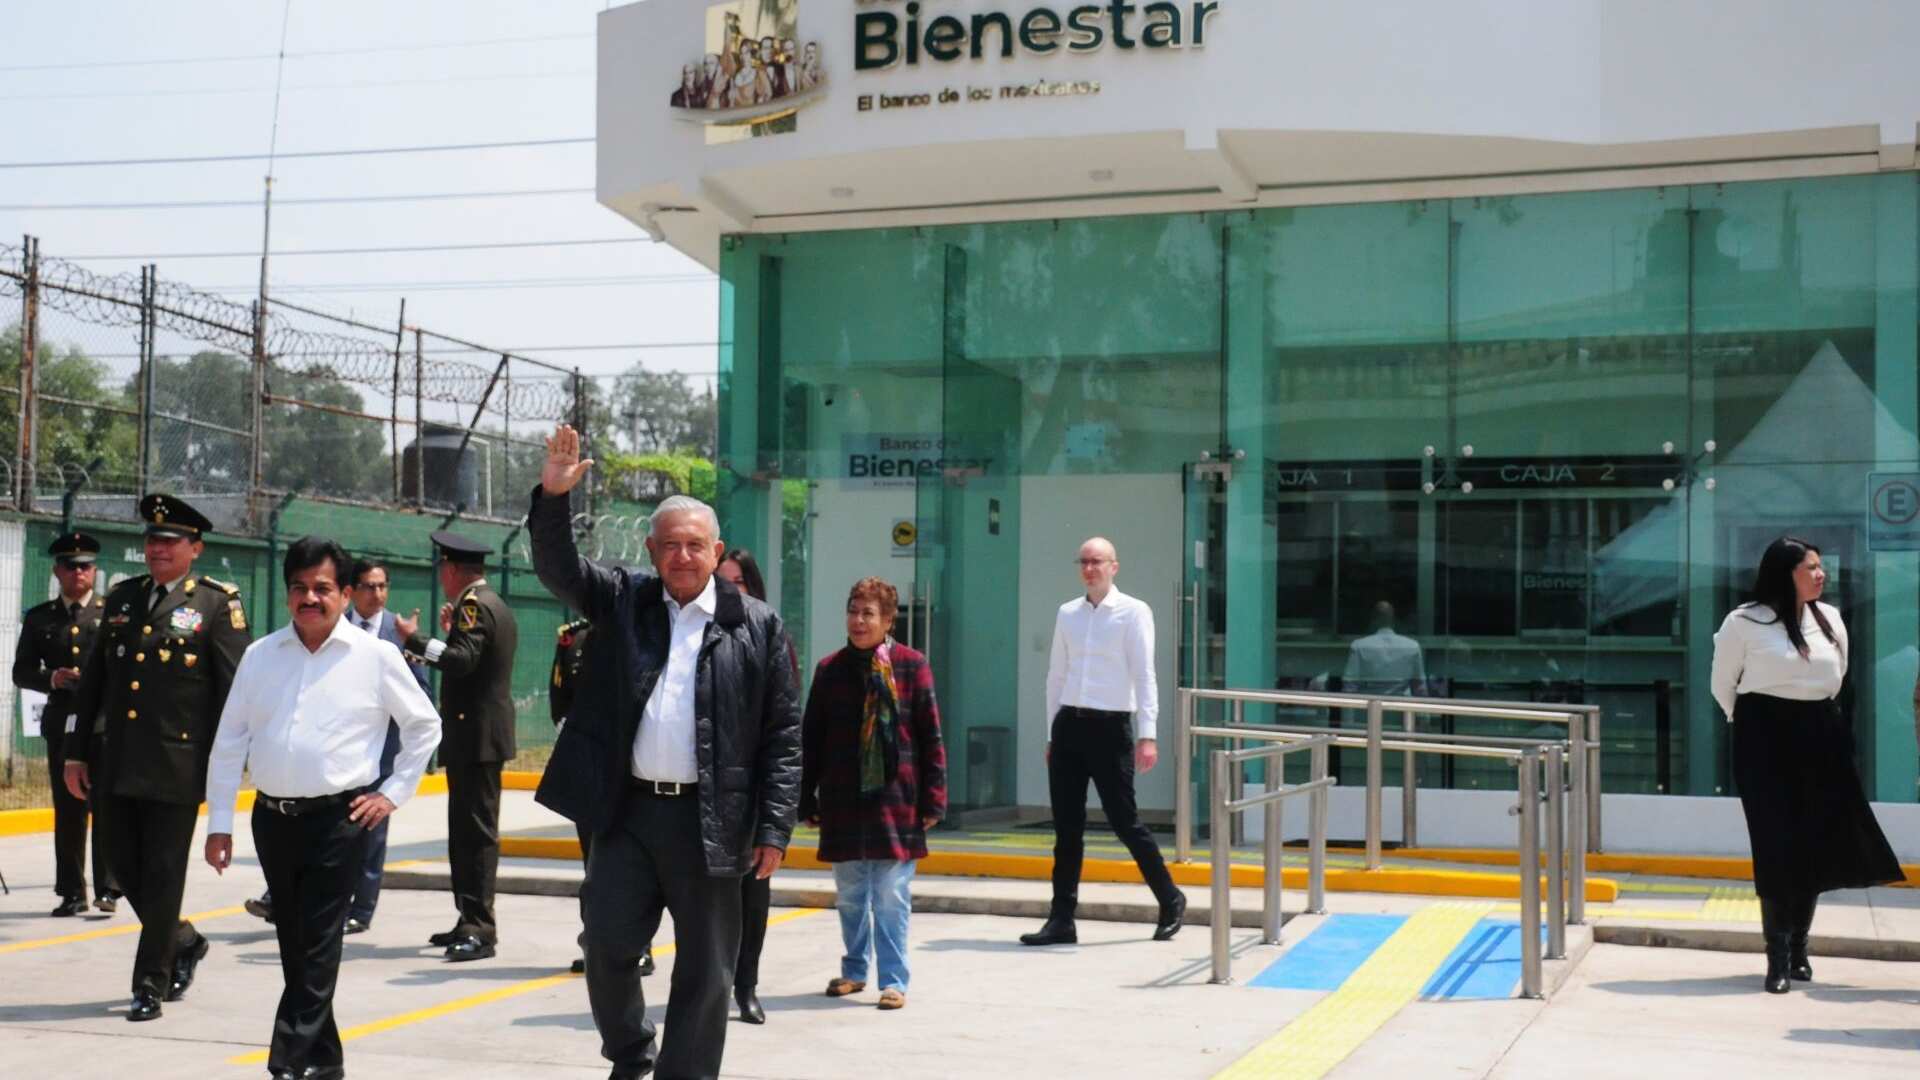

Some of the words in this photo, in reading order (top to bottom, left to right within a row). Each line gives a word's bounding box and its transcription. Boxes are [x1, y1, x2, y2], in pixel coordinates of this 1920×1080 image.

[855, 1, 1218, 69] Bienestar
[857, 96, 873, 111] El
[880, 93, 931, 109] banco
[938, 88, 960, 104] de
[1343, 467, 1351, 485] 1
[1500, 463, 1576, 482] CAJA
[1600, 463, 1616, 481] 2
[1887, 487, 1906, 516] E
